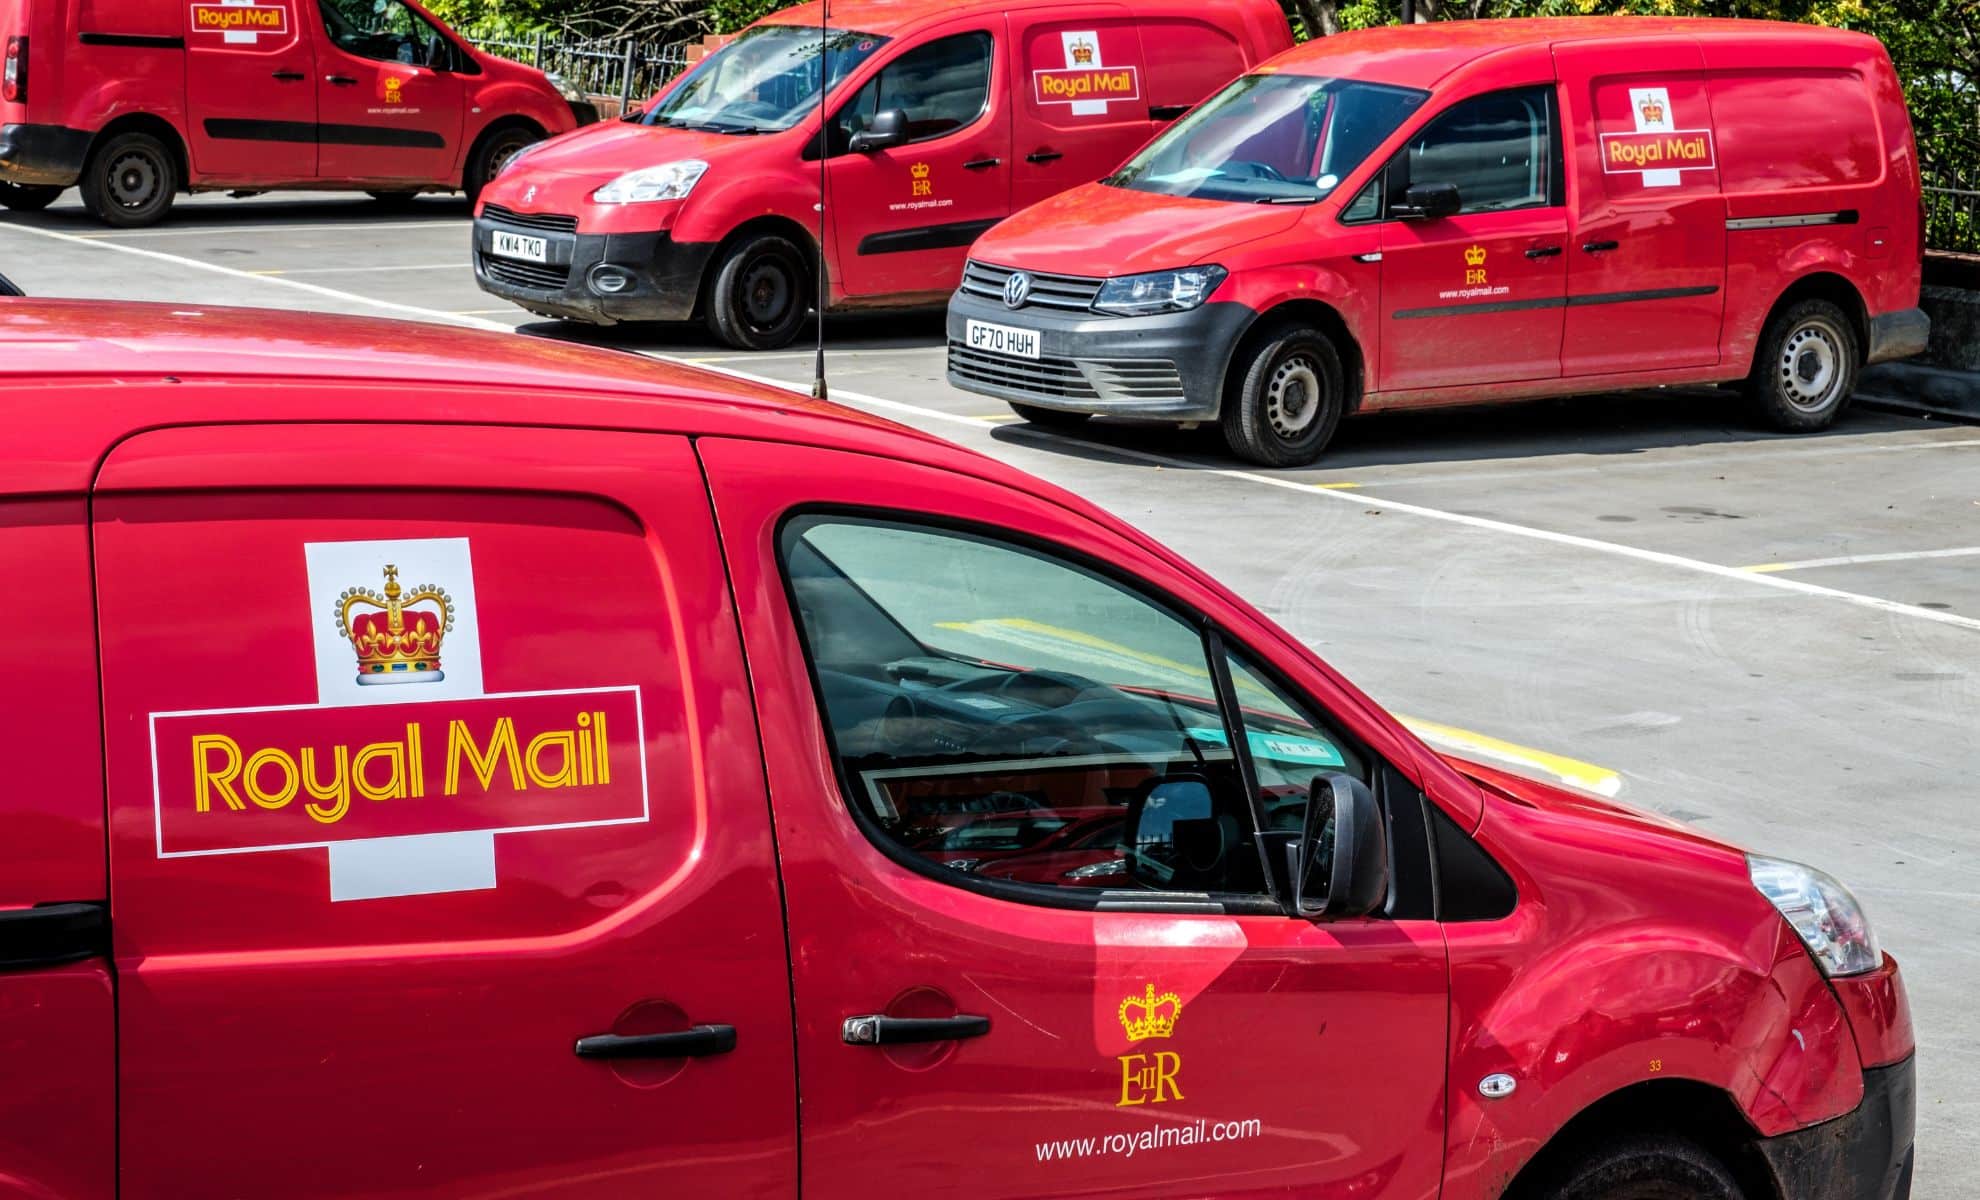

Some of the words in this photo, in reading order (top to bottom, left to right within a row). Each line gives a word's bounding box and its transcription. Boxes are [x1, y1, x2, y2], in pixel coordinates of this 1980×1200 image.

[198, 8, 243, 28] Royal
[246, 10, 280, 26] Mail
[1042, 73, 1091, 97] Royal
[1094, 72, 1130, 92] Mail
[1610, 139, 1663, 166] Royal
[1667, 137, 1706, 160] Mail
[1440, 286, 1510, 299] www.royalmail.com
[972, 325, 1003, 349] GF70
[1007, 331, 1034, 355] HUH
[192, 722, 425, 824] Royal
[444, 711, 610, 796] Mail
[1649, 1059, 1662, 1072] 33
[1035, 1118, 1262, 1161] www.royalmail.com
